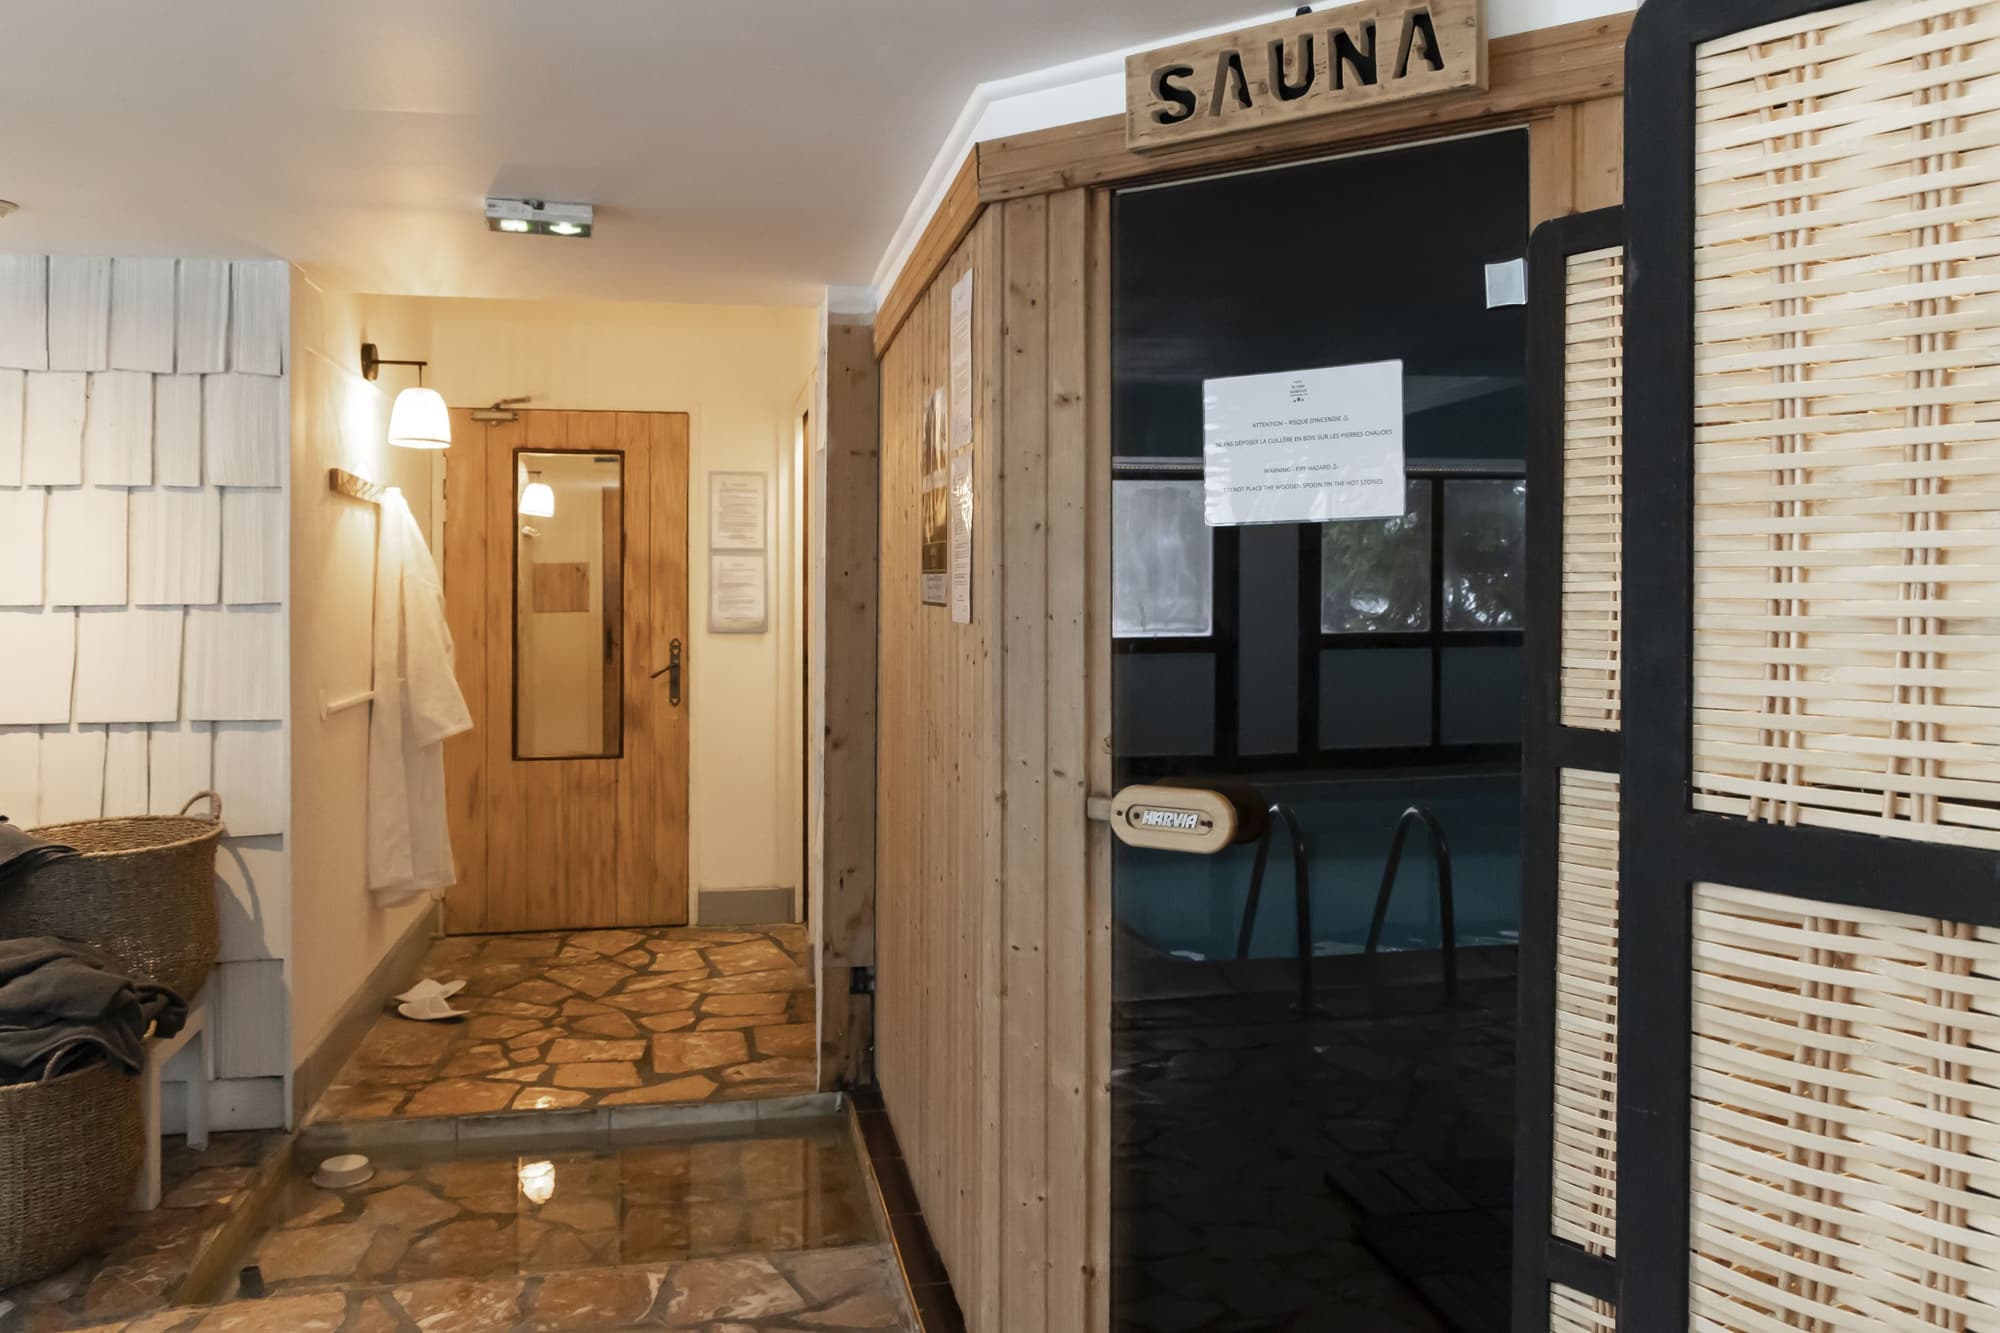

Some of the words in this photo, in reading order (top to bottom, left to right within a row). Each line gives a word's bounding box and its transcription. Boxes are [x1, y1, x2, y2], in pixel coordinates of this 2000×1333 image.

[1150, 6, 1445, 125] SAUNA
[1252, 420, 1283, 428] ATTENTION
[1317, 432, 1328, 440] SUR
[1341, 430, 1363, 438] PIERRES
[1364, 428, 1392, 437] CHAUDES
[1308, 463, 1331, 471] HAZARD
[1275, 482, 1301, 490] WOODEN
[1142, 809, 1199, 829] HARVIA
